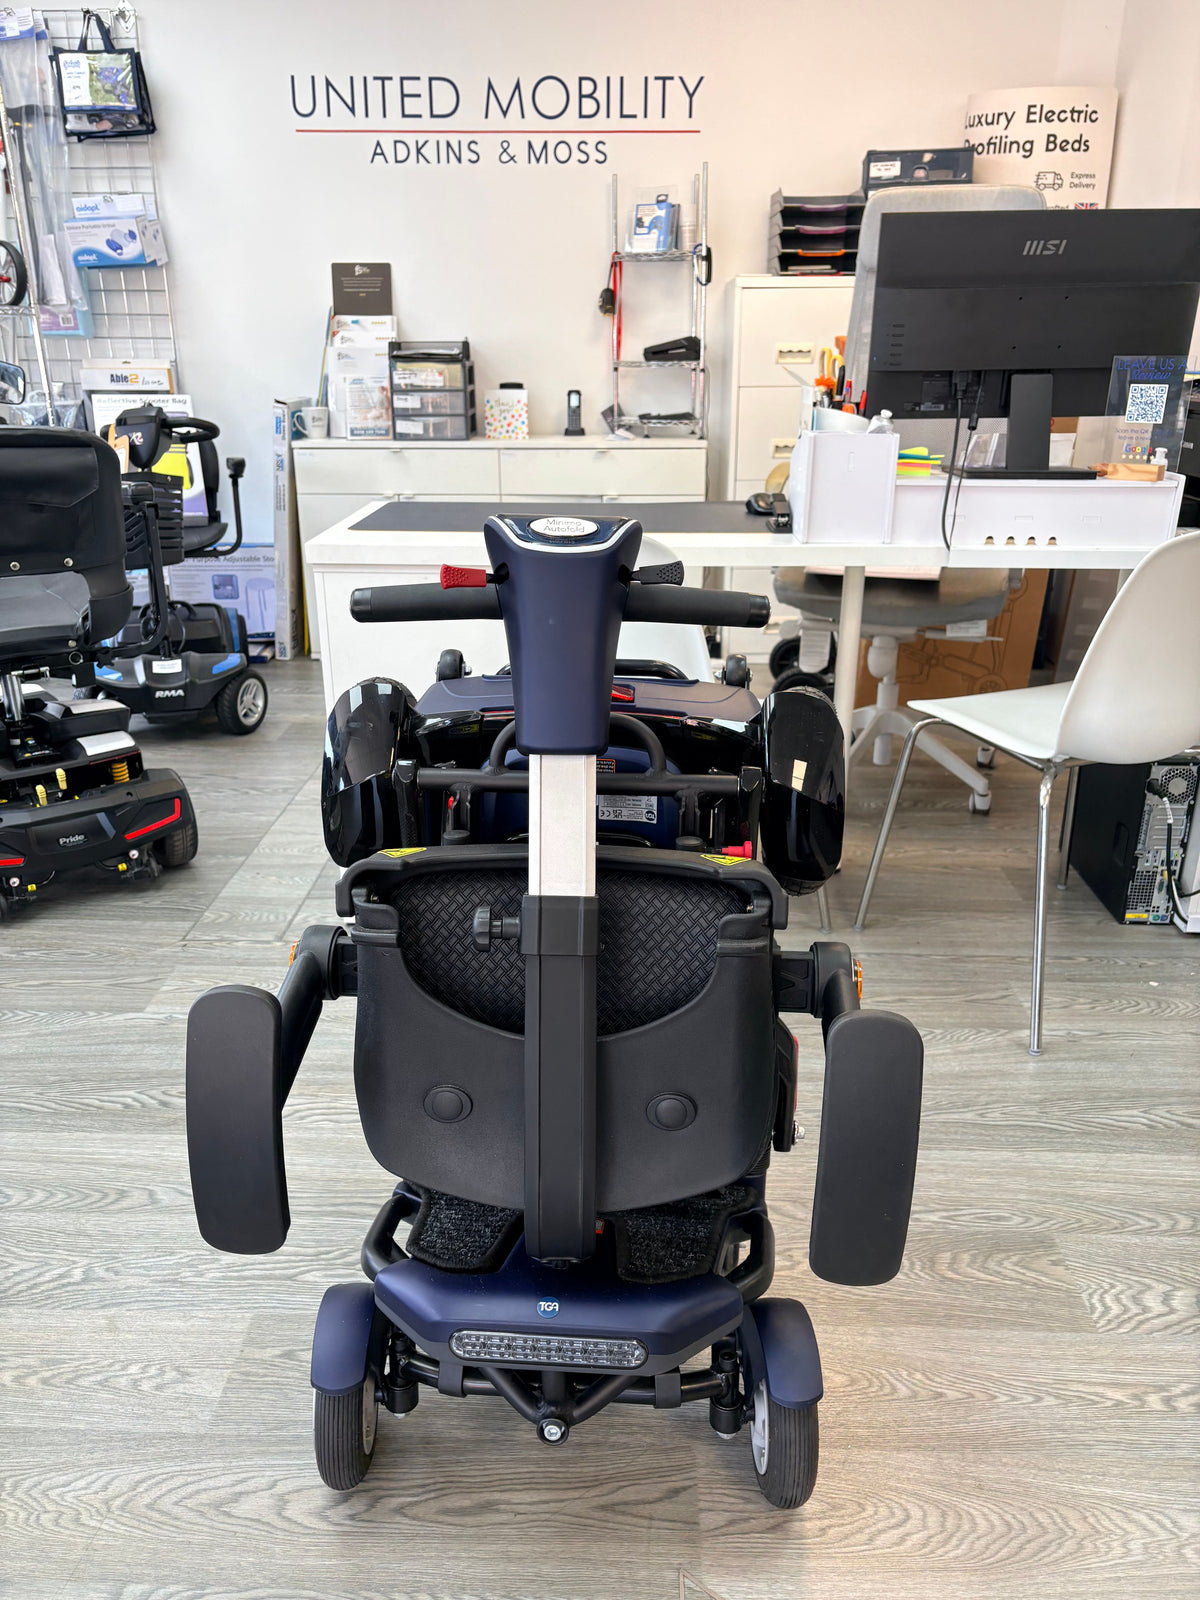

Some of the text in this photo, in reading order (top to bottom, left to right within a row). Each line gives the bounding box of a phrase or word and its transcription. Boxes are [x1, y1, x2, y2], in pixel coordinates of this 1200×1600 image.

[291, 75, 705, 120] UNITED MOBILITY
[1026, 104, 1099, 123] Electric
[1045, 133, 1090, 152] Beds
[370, 140, 608, 164] ADKINS & MOSS
[1070, 172, 1096, 180] Express
[1069, 182, 1096, 190] Delivery
[1117, 358, 1155, 370] LEAVE
[1160, 358, 1175, 370] US
[1131, 369, 1172, 380] Review
[1124, 443, 1153, 455] Google
[155, 689, 185, 698] RMA
[59, 834, 85, 845] Pride
[539, 1301, 559, 1311] TGA
